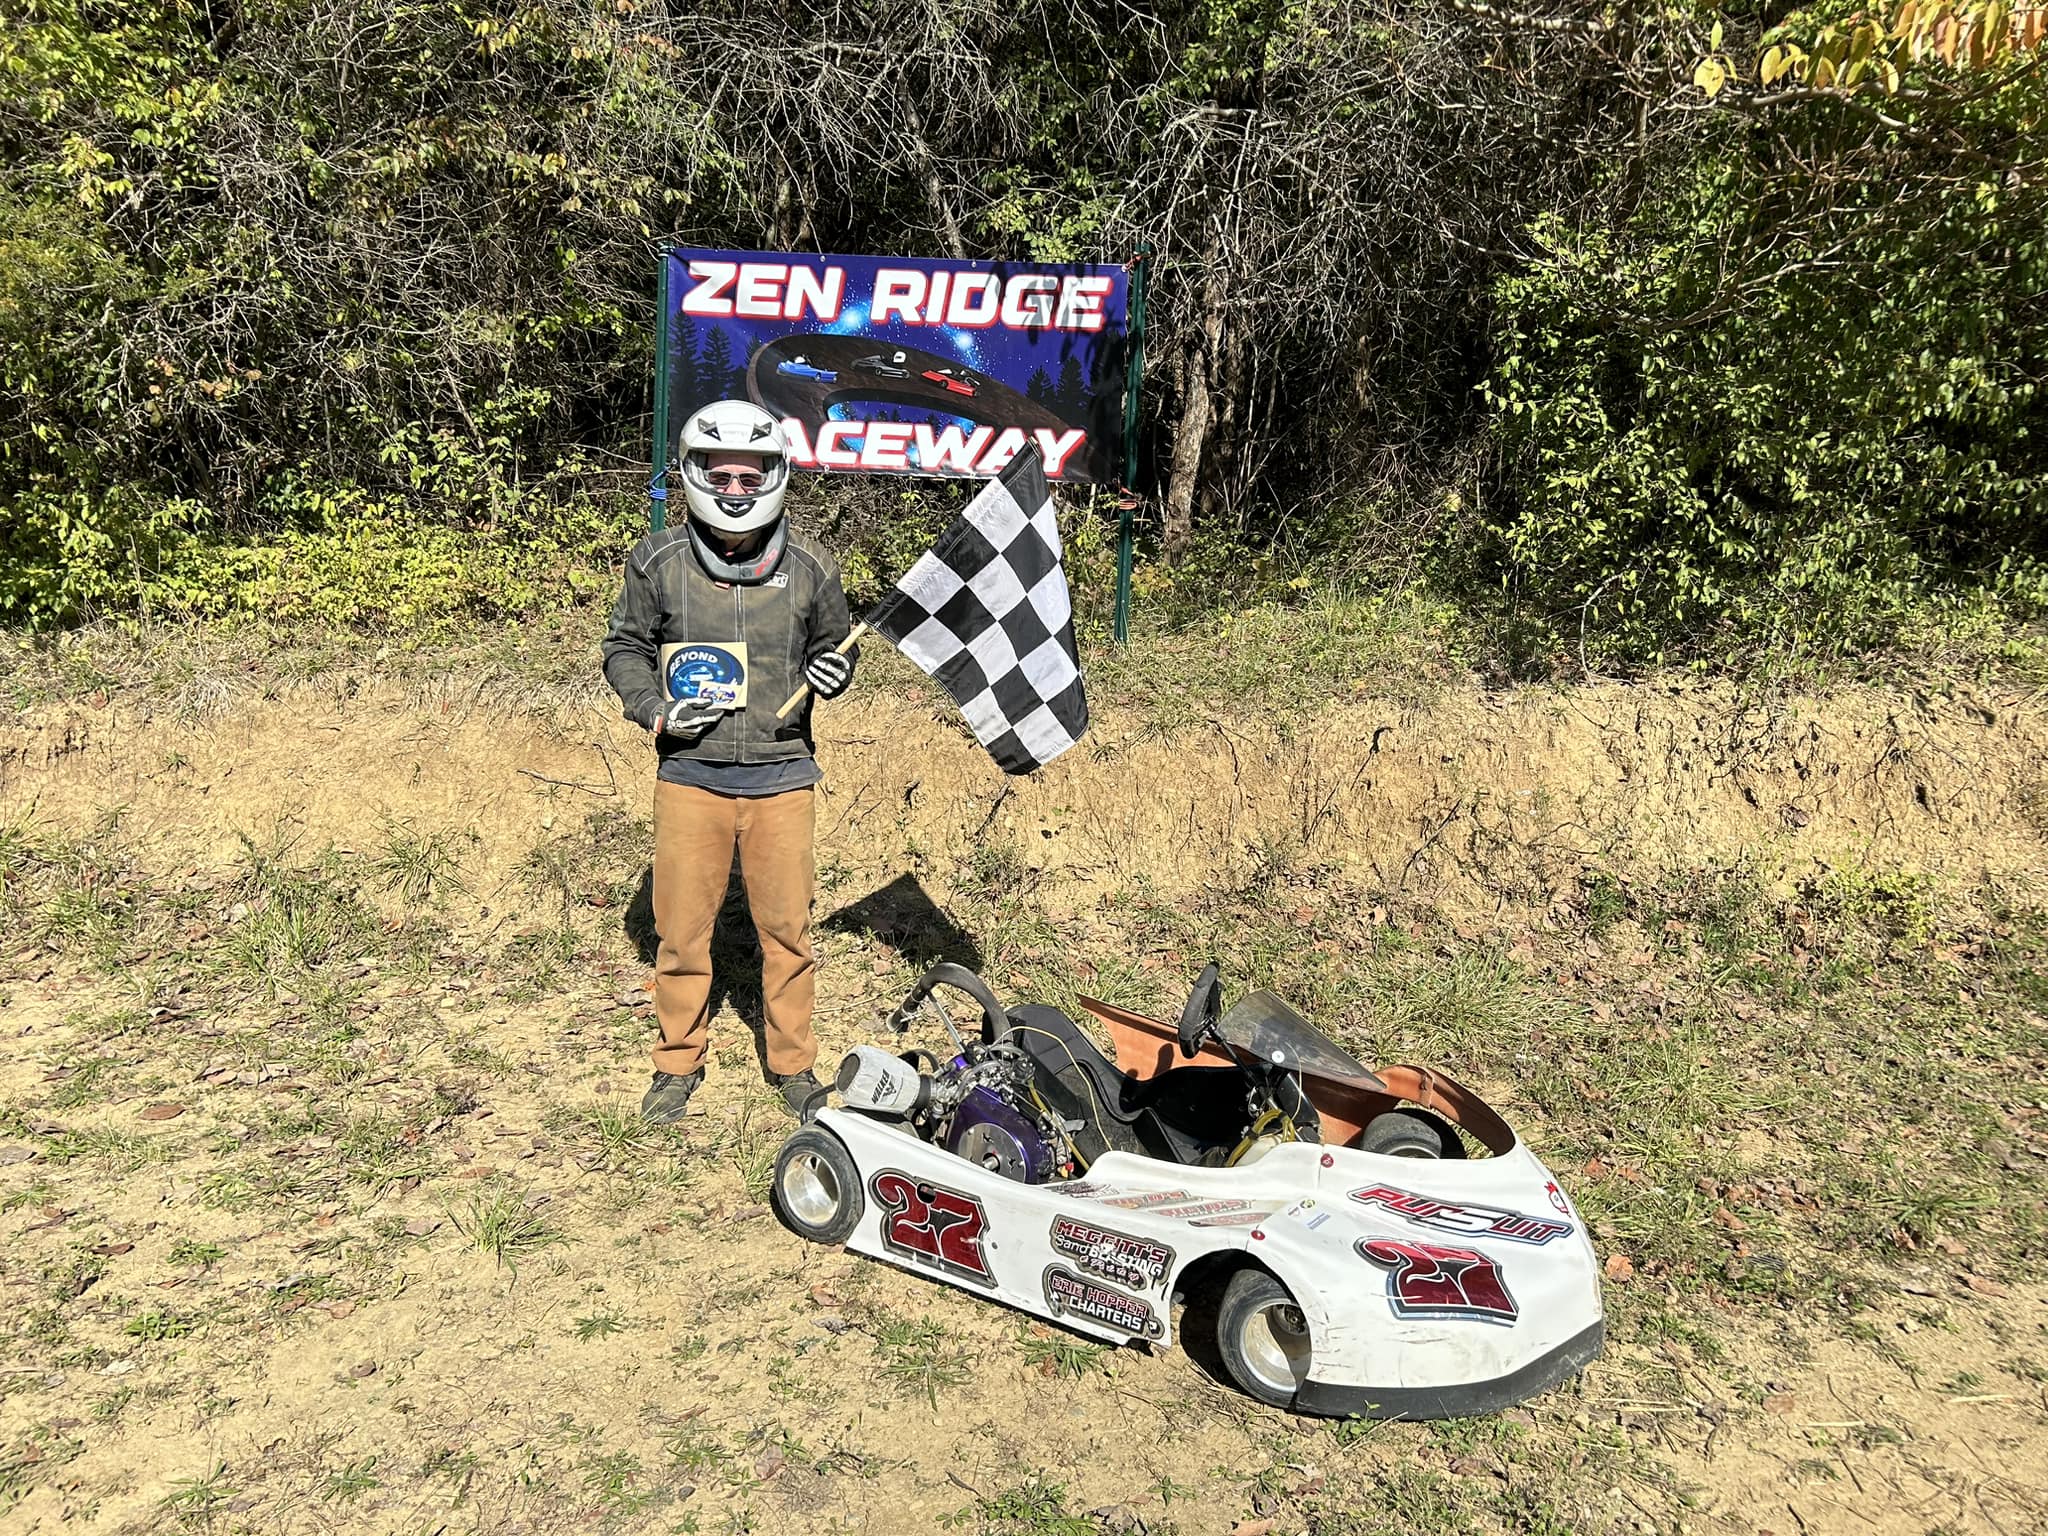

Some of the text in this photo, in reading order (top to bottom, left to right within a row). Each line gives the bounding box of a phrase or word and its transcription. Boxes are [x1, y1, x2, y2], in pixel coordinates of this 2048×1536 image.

[682, 261, 1112, 331] ZEN RIDGE
[779, 417, 1087, 477] ACEWAY
[873, 1170, 992, 1281] 27
[1087, 1286, 1148, 1319] HOPPER
[1359, 1238, 1518, 1319] 27
[1069, 1295, 1143, 1331] CHARTERS
